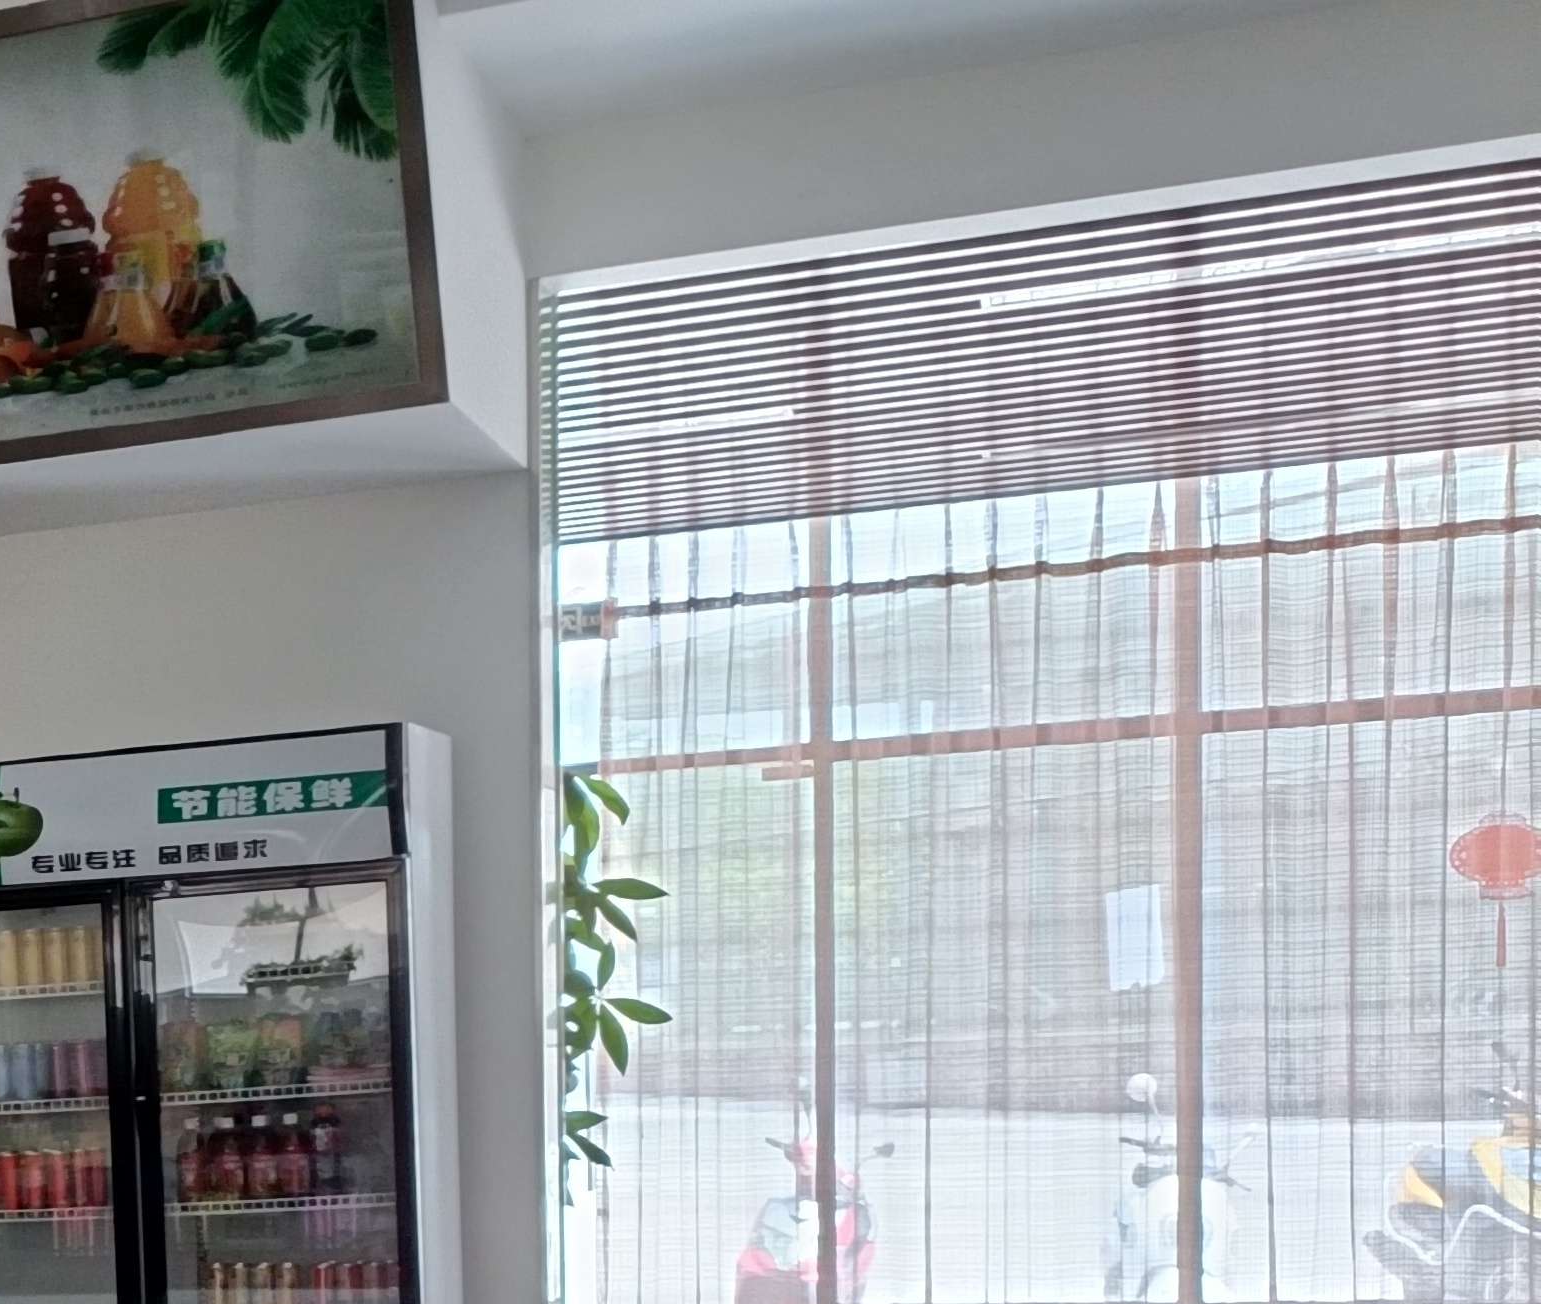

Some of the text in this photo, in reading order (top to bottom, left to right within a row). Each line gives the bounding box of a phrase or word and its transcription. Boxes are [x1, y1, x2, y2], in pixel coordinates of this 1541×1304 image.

[173, 776, 357, 821] 节能保鲜
[30, 837, 270, 875] 专业专注 品质追求
